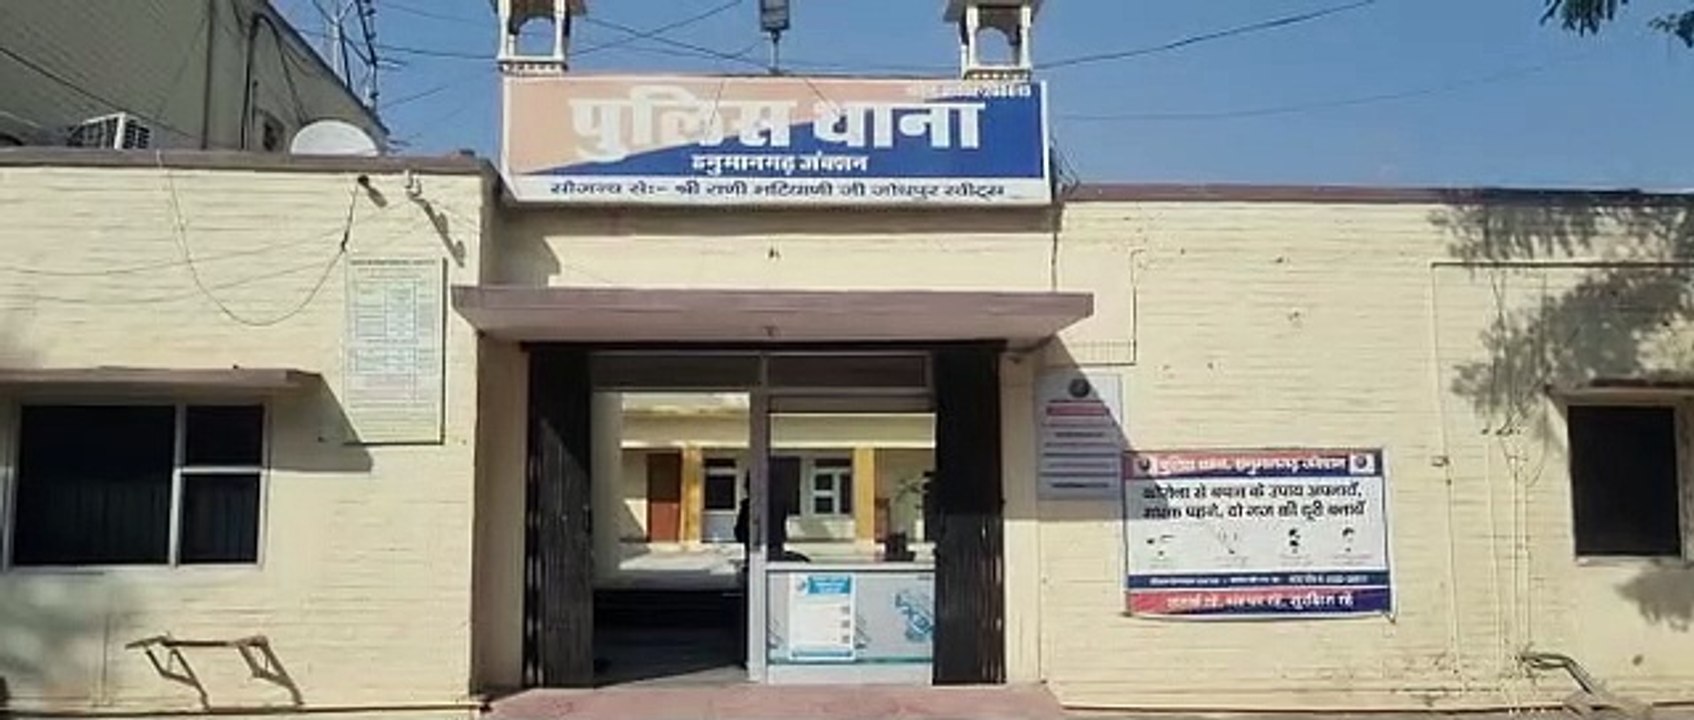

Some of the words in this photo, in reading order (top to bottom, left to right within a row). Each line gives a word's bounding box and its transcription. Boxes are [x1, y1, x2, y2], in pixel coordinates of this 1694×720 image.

[569, 85, 798, 162] पुलिस
[812, 101, 986, 149] थाना
[675, 180, 700, 195] श्री
[841, 181, 865, 197] जी
[872, 181, 938, 200] जोधपुर
[1268, 484, 1304, 498] उपाय
